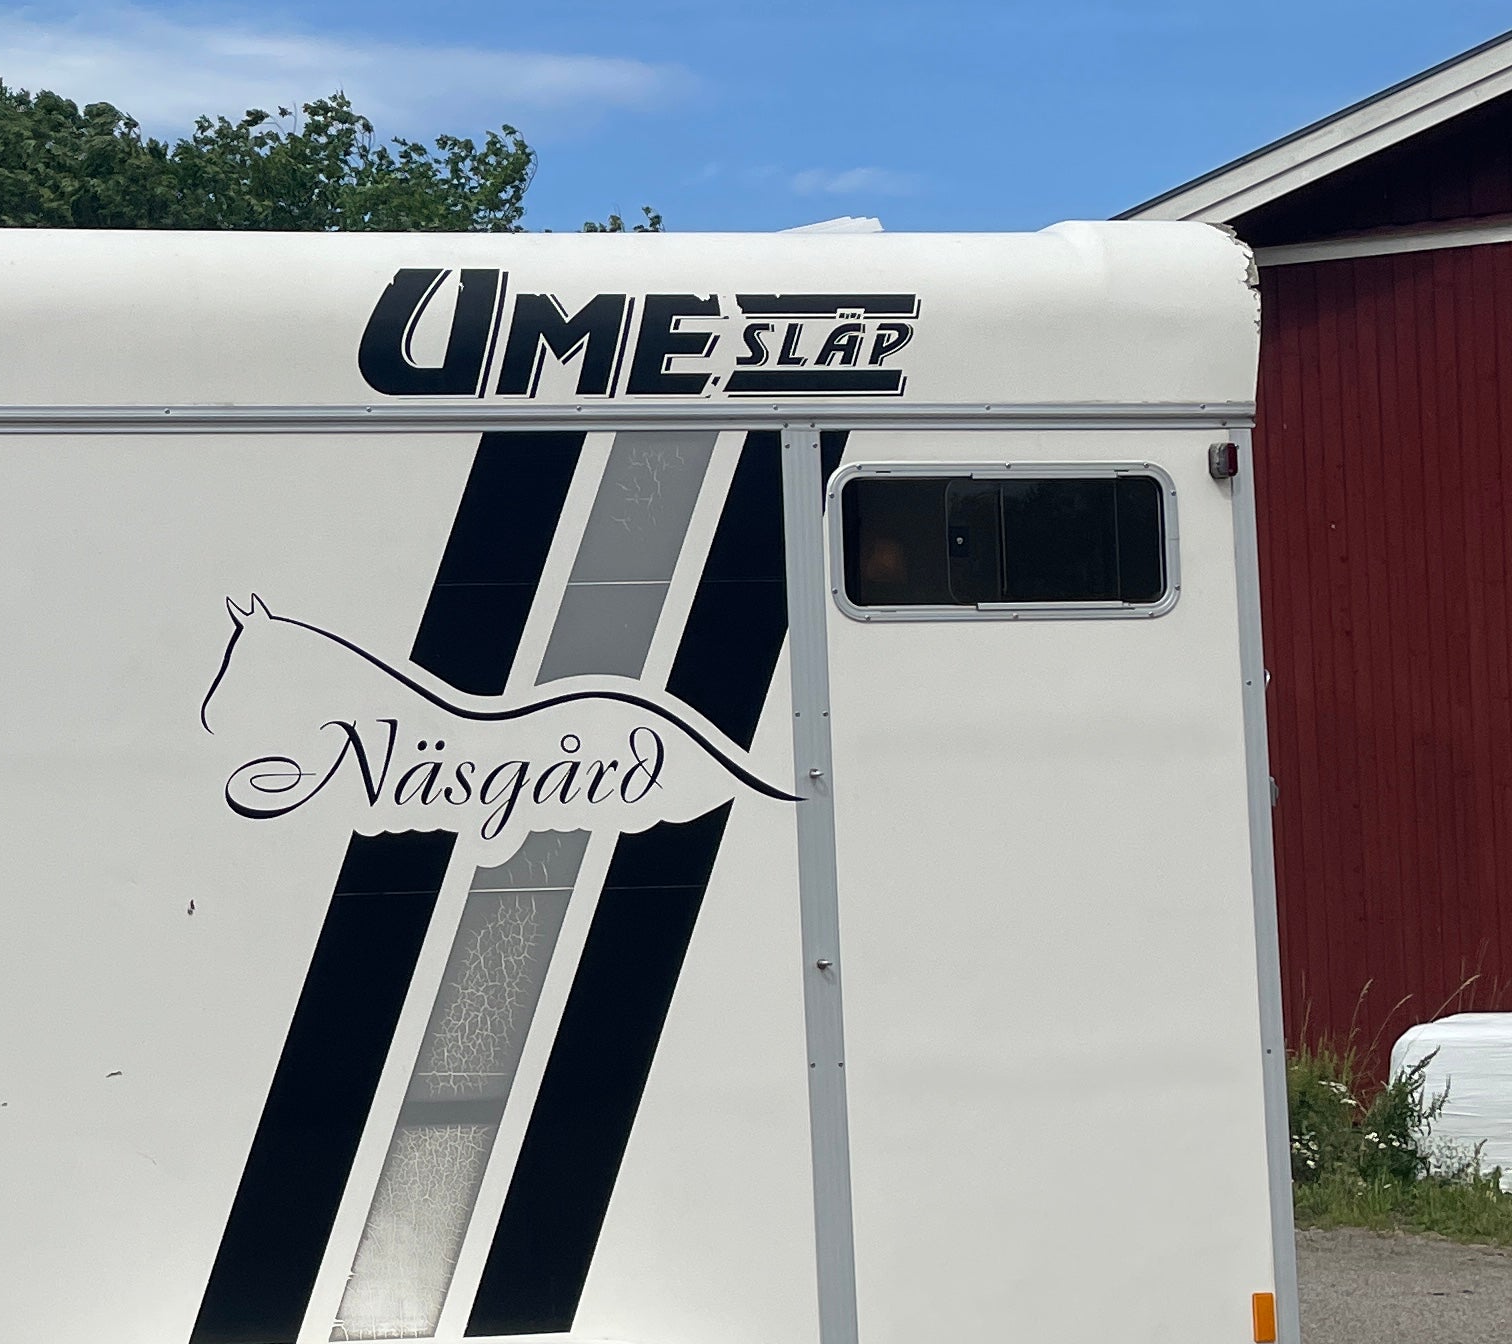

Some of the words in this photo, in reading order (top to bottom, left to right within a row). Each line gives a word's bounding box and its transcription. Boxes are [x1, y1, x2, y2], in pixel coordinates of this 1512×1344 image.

[358, 268, 728, 398] UME
[735, 312, 914, 367] SLÄP
[224, 718, 665, 840] Näsgård
